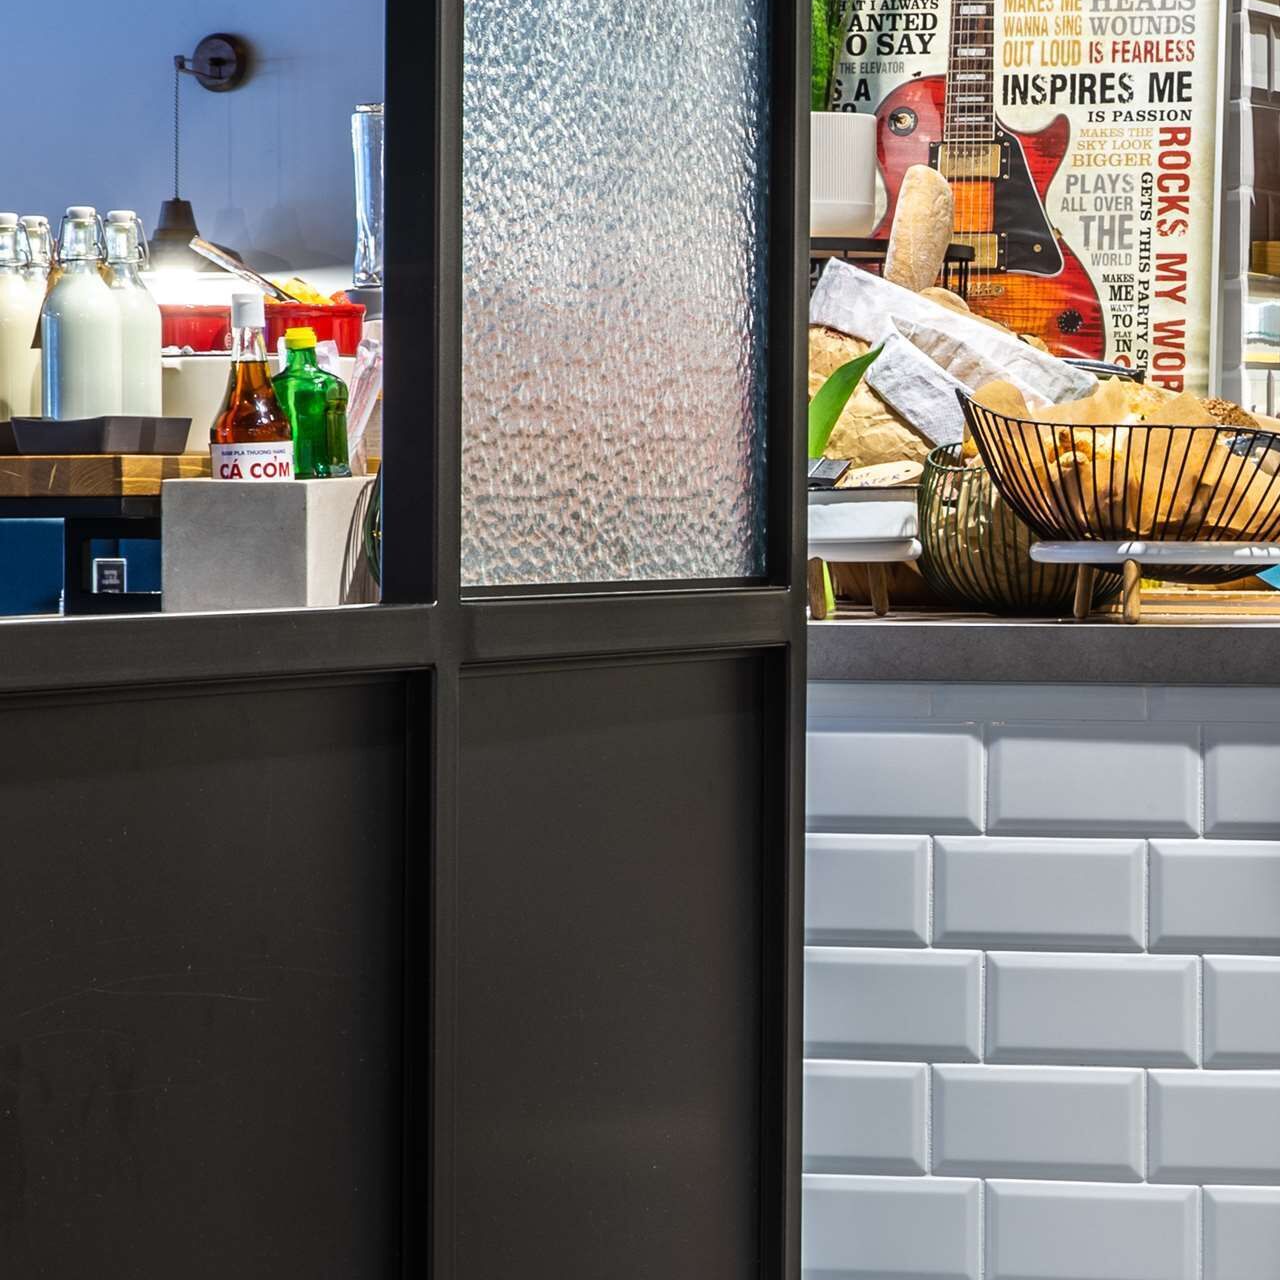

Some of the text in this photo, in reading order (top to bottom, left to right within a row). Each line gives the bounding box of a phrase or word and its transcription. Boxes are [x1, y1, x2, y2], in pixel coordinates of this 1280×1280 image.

[870, 0, 876, 11] I
[880, 0, 939, 10] ALWAYS
[839, 12, 938, 33] ANTED
[1003, 15, 1083, 37] WANNA SING
[1089, 15, 1196, 36] WOUNDS
[846, 33, 936, 56] O SAY
[1003, 39, 1082, 67] OUT LOUD
[1089, 39, 1196, 63] IS FEARLESS
[860, 61, 905, 74] ELEVATOR
[853, 78, 871, 101] A
[1002, 71, 1193, 105] INSPIRES ME
[1088, 109, 1193, 122] IS PASSION
[1080, 127, 1153, 138] MAKES THE
[1077, 139, 1153, 151] SKY LOOK
[1072, 153, 1153, 168] BIGGER
[1065, 173, 1135, 194] PLAYS
[1156, 126, 1192, 237] ROCKS
[1060, 196, 1134, 212] ALL OVER
[1140, 171, 1154, 221] GETS
[1079, 214, 1134, 251] THE
[1091, 253, 1132, 267] WORLD
[1138, 227, 1152, 273] THIS
[1102, 274, 1135, 283] MAKES
[1154, 253, 1187, 305] MY
[1109, 284, 1134, 302] ME
[1110, 304, 1135, 312] WANT
[1136, 280, 1150, 343] PARTY
[1112, 314, 1133, 328] TO
[1115, 339, 1133, 353] IN
